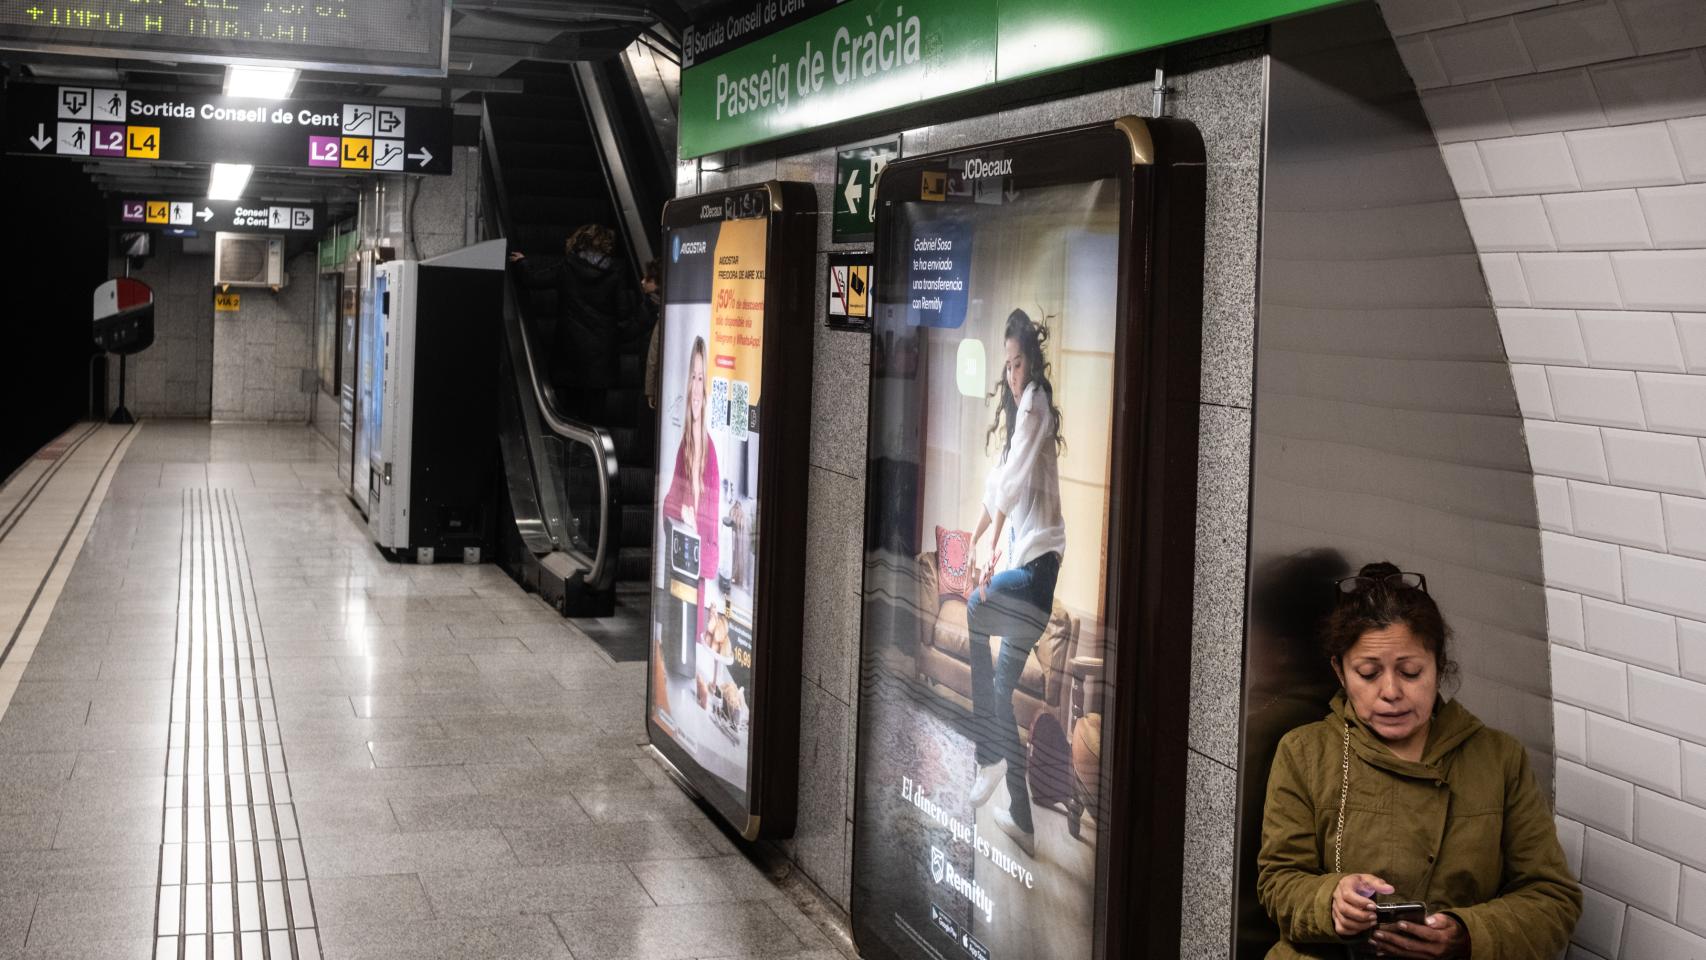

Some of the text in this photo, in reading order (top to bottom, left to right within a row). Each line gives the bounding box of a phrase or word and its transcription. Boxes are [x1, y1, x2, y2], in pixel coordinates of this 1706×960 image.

[694, 22, 725, 55] Sortida
[726, 4, 762, 41] Consell
[763, 0, 777, 25] de
[716, 5, 921, 121] Passeig de Gràcia
[130, 99, 340, 127] Sortida Consell de Cent
[94, 130, 157, 152] L2 L4
[311, 141, 370, 163] L2 L4
[962, 158, 1014, 180] JCDecaux
[123, 204, 167, 219] L2 L4
[235, 206, 268, 218] Consell
[233, 216, 268, 227] de Cent
[680, 241, 707, 255] AIGOSTAR
[914, 238, 952, 251] Gabriel Sosa
[913, 257, 953, 271] te ha enviado
[912, 276, 963, 291] una transferencia
[912, 296, 943, 313] con Remitly
[902, 775, 1034, 889] El dinero que les mueve
[945, 862, 995, 923] Remitly
